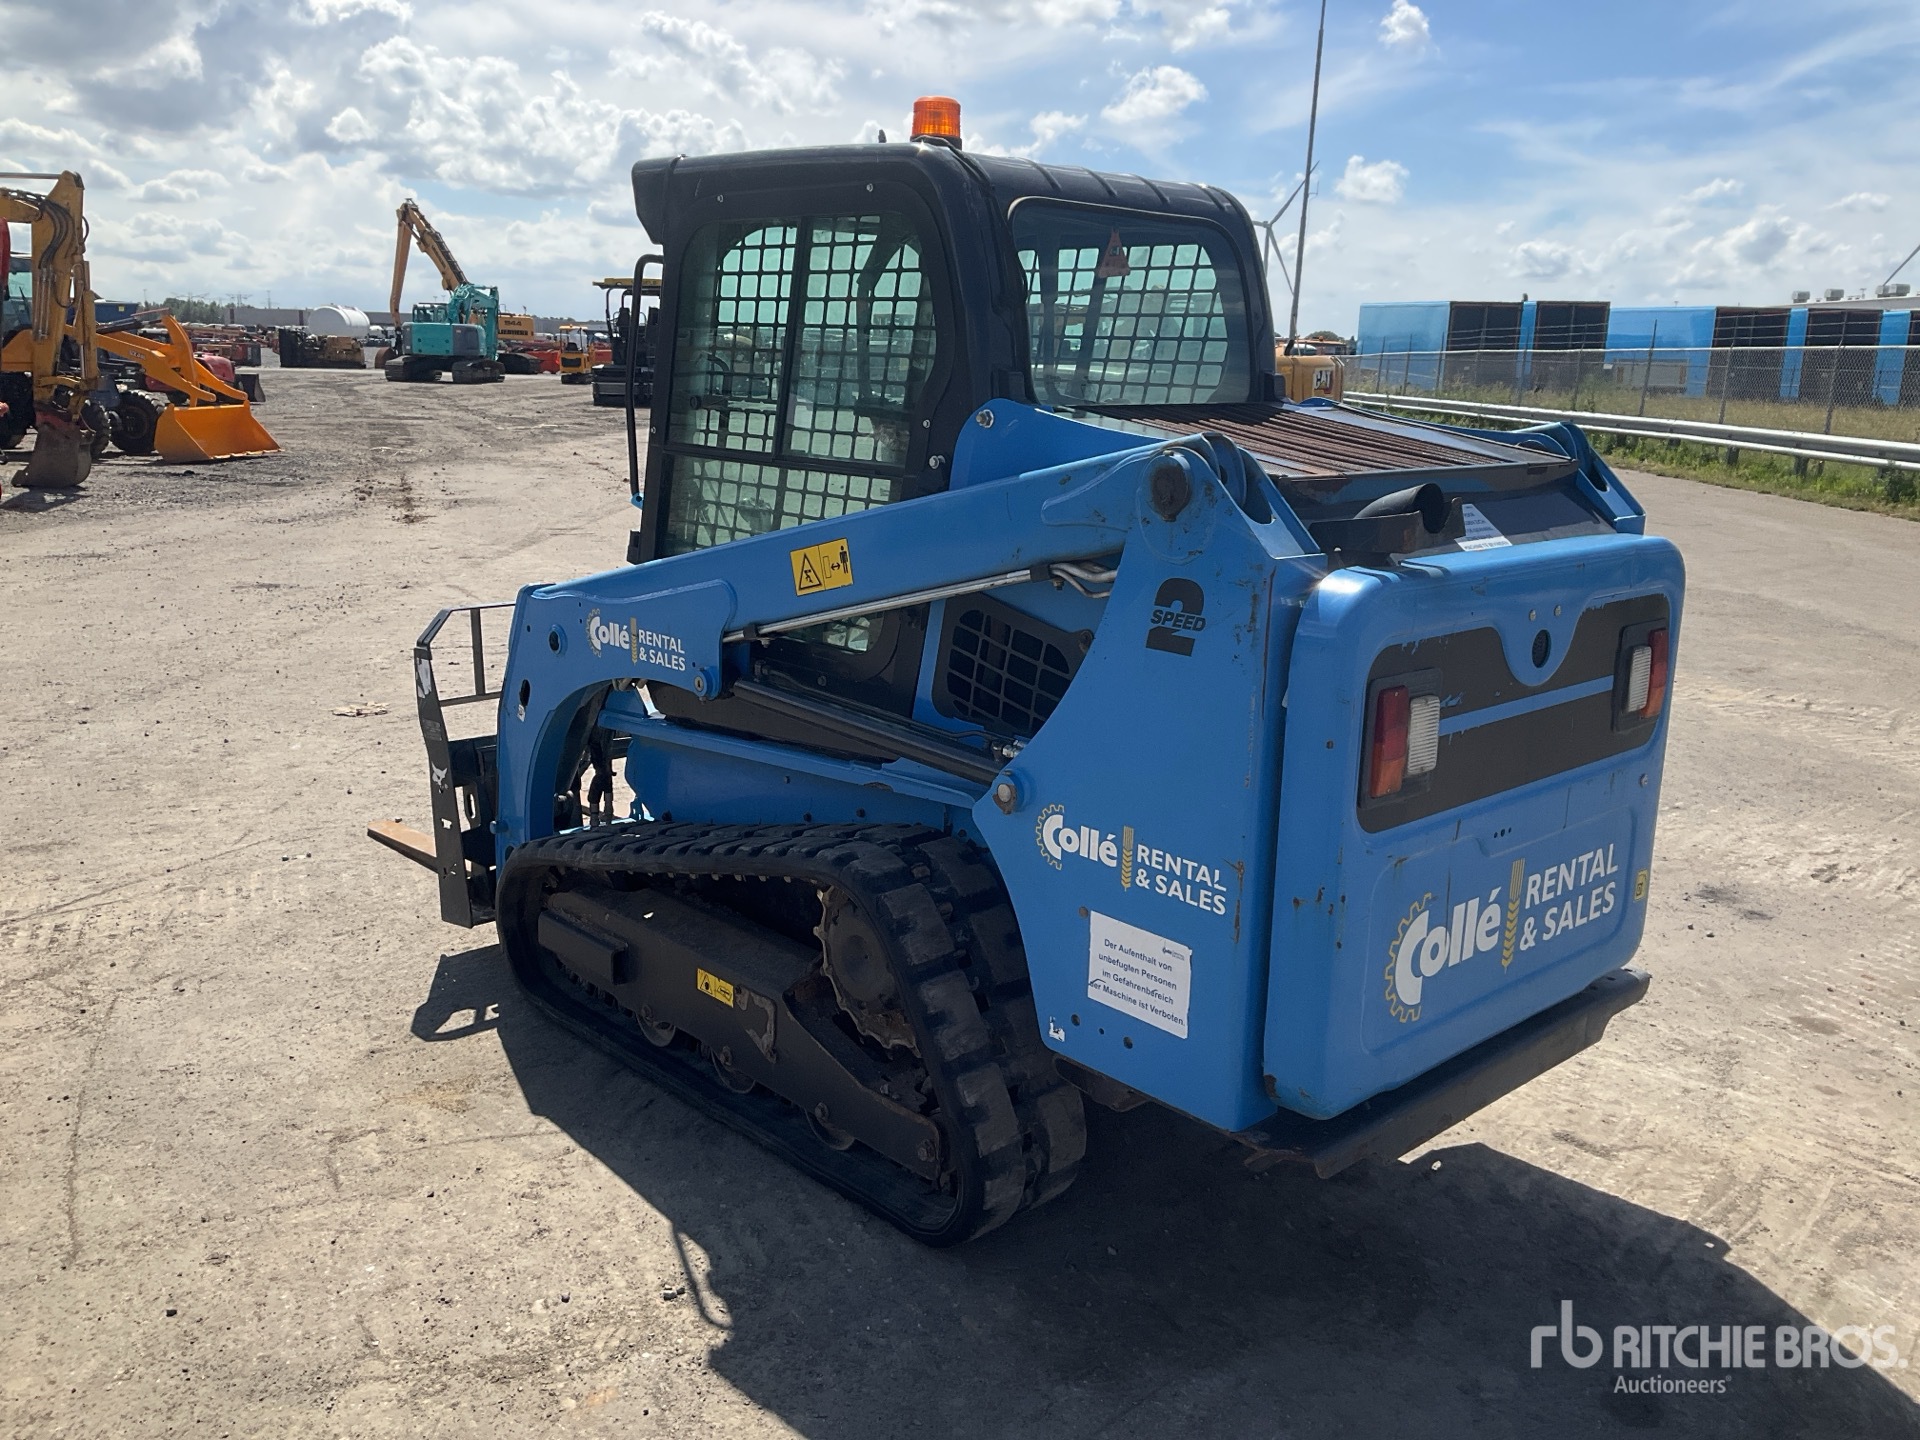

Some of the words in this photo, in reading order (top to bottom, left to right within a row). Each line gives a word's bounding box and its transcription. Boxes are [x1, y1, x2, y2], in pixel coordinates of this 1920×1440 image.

[1313, 369, 1331, 390] CAT
[589, 616, 631, 651] Collé
[1146, 577, 1205, 657] 2
[1150, 609, 1207, 632] SPEED
[638, 629, 686, 655] RENTAL
[639, 646, 648, 662] &
[649, 649, 687, 672] SALES
[1042, 814, 1119, 868] Collé
[1136, 843, 1228, 892] RENTAL
[1524, 843, 1619, 910] RENTAL
[1135, 868, 1150, 890] &
[1154, 874, 1227, 916] SALES
[1519, 916, 1539, 951] &
[1542, 881, 1617, 942] SALES
[1104, 938, 1118, 951] Der
[1118, 944, 1157, 966] Aufenthalt
[1158, 962, 1173, 972] von
[1394, 886, 1503, 1006] Collé
[1098, 953, 1140, 975] unbefugten
[1141, 969, 1177, 991] Personen
[1102, 969, 1112, 979] im
[1112, 973, 1174, 1005] Gefahrenbereich
[1102, 984, 1137, 1006] Maschine
[1138, 999, 1148, 1011] ist
[1149, 1004, 1186, 1027] Verboten.
